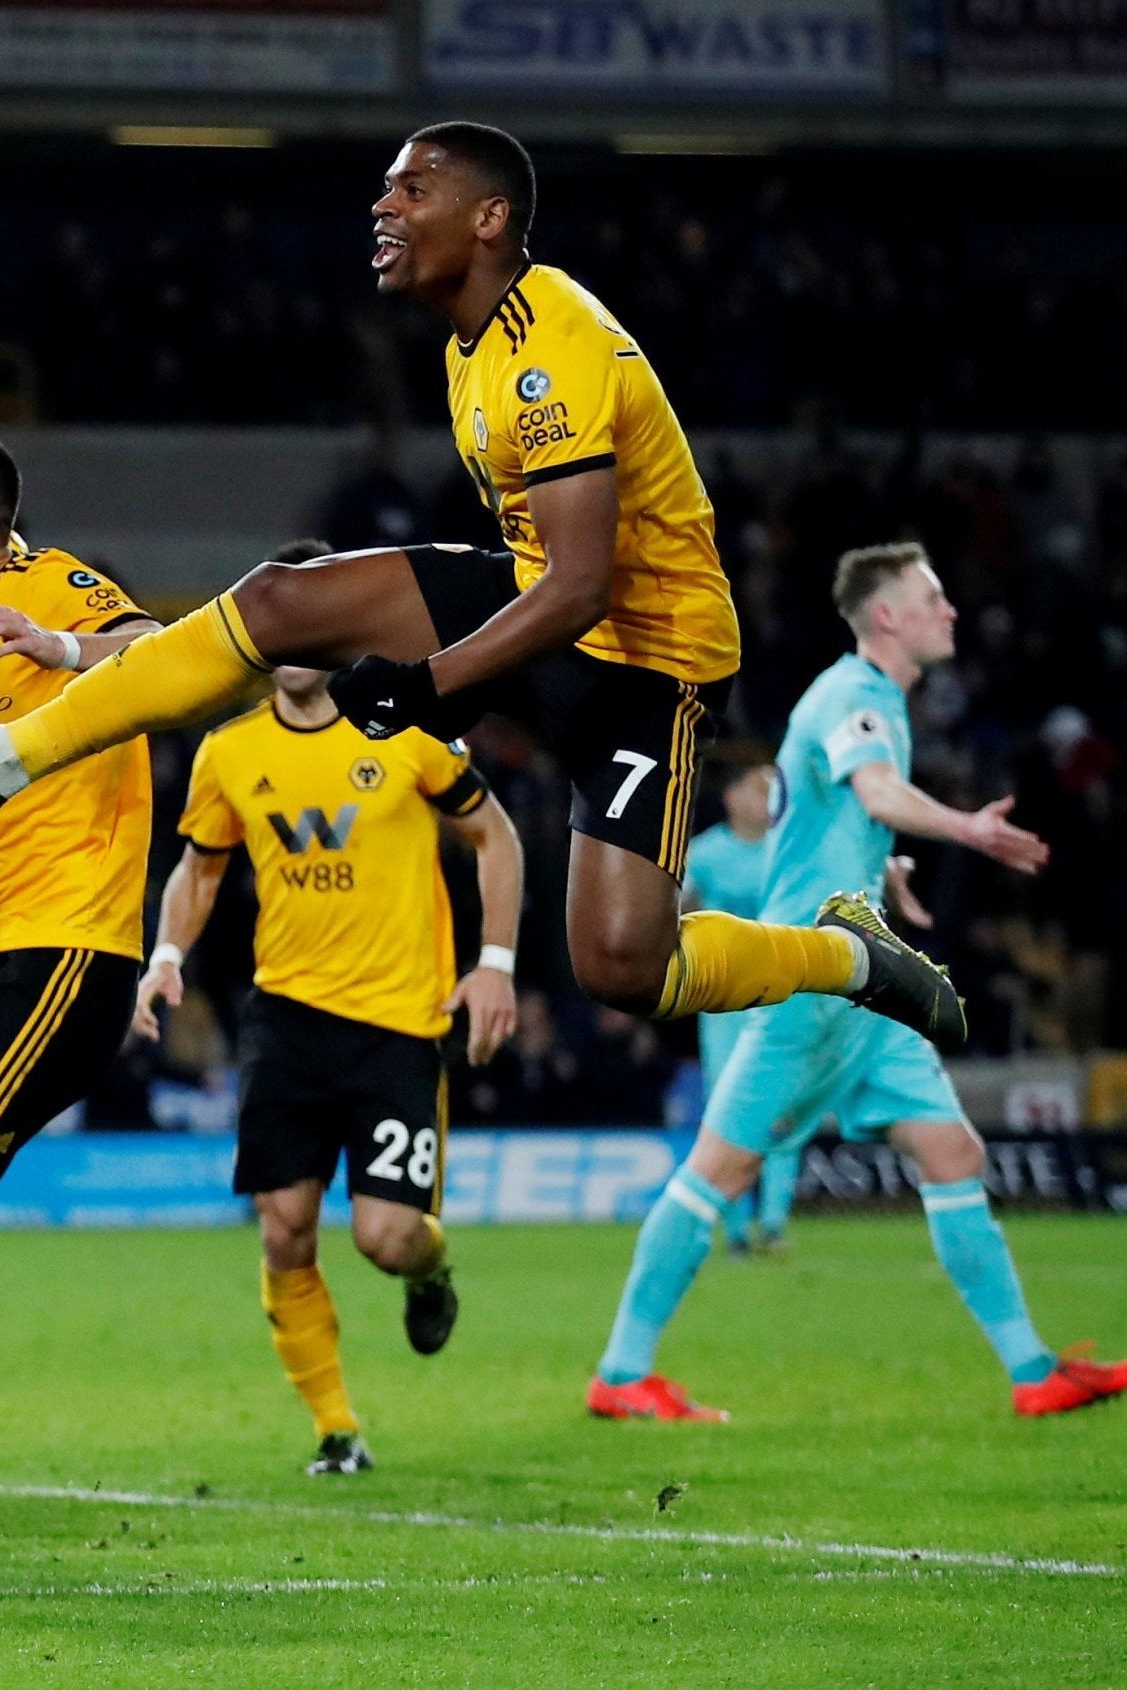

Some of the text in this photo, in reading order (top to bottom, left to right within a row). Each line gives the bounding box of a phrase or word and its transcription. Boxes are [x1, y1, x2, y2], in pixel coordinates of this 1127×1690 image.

[605, 749, 658, 819] 7
[280, 861, 354, 892] W88
[366, 1118, 439, 1188] 28
